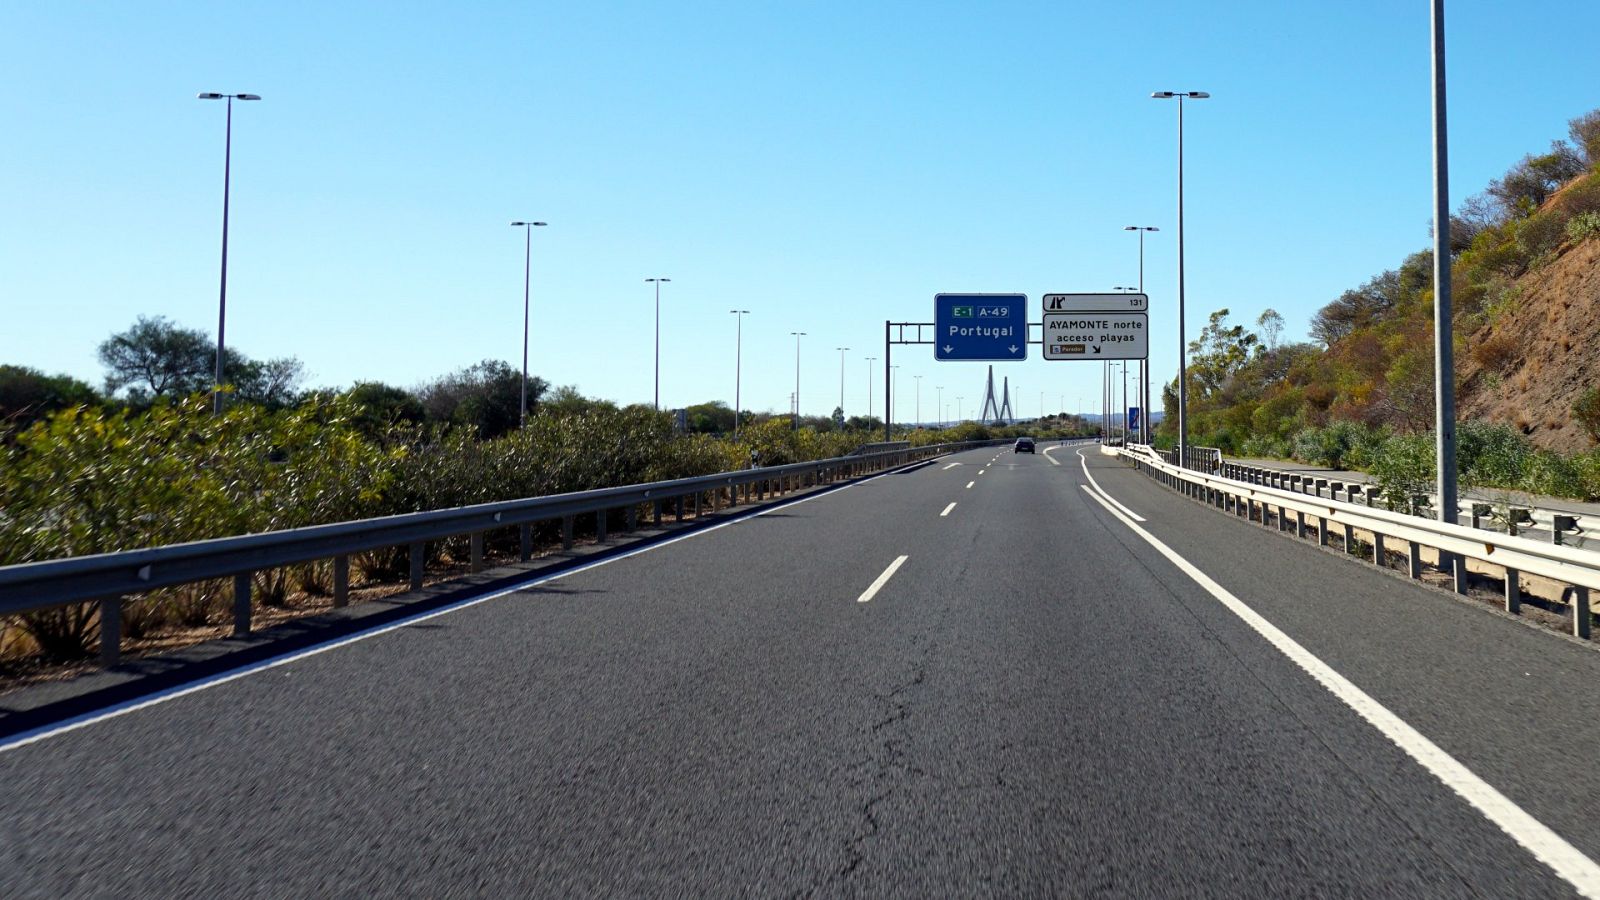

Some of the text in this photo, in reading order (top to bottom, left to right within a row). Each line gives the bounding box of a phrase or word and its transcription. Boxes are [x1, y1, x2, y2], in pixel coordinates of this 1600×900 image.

[1129, 299, 1143, 307] 131
[953, 306, 1008, 316] E-1 A-49
[1049, 320, 1143, 329] AYAMONTE norte
[949, 325, 1013, 339] Portugal
[1100, 333, 1135, 343] playas
